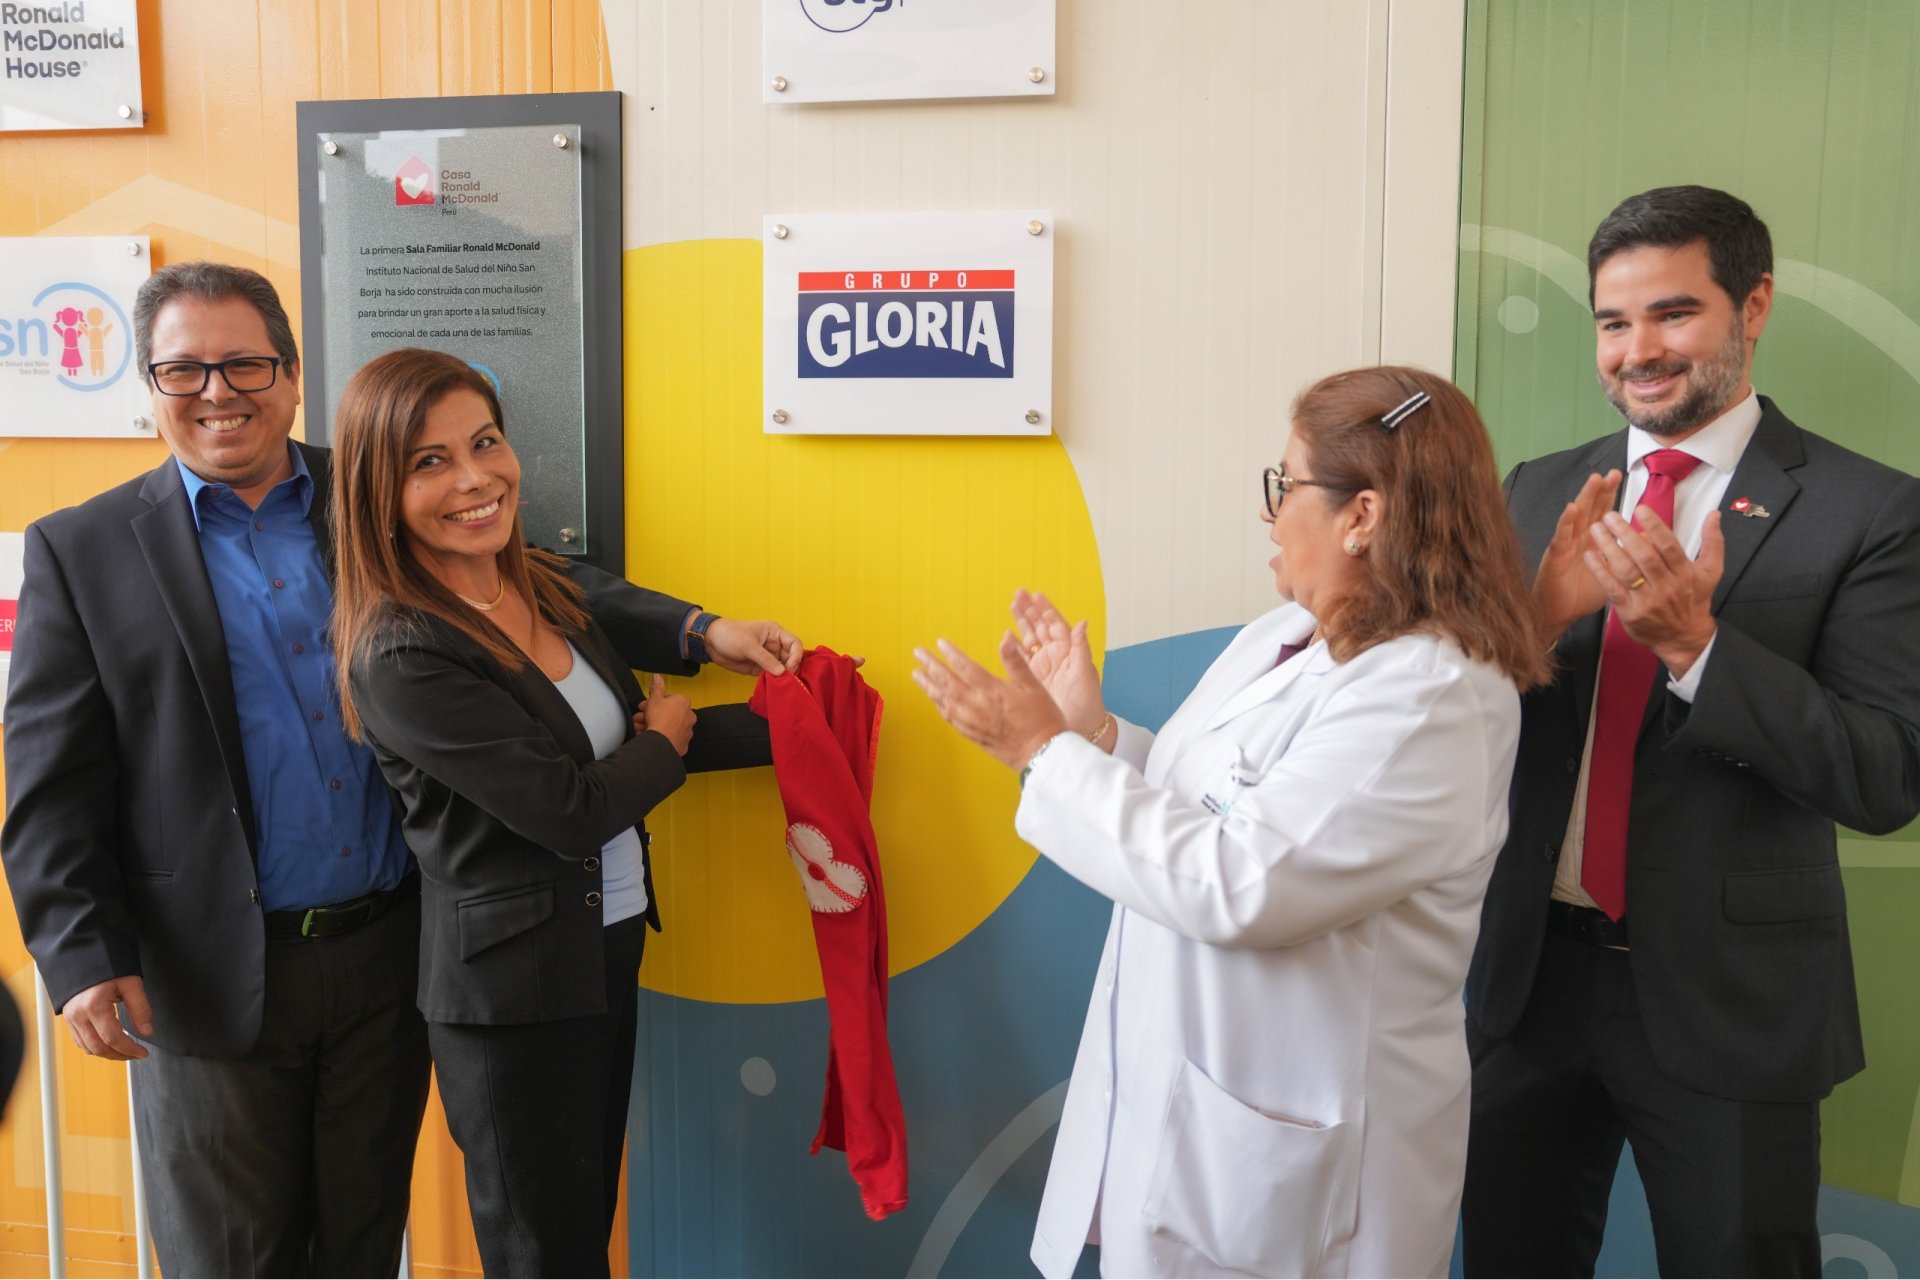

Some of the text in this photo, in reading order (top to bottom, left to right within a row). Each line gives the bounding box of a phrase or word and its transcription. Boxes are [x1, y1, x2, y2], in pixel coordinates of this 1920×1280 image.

[1, 1, 85, 24] Ronald
[4, 27, 124, 51] McDonald
[441, 170, 471, 179] Casa
[441, 181, 480, 191] Ronald
[441, 192, 499, 204] McDonald
[360, 242, 540, 256] La primera Sala Familiar Ronald McDonald
[366, 263, 536, 276] Instituto Nacional de Salud del Niño San
[844, 271, 968, 289] GRUPO
[360, 288, 382, 298] Borja
[385, 287, 396, 296] ha
[397, 286, 415, 296] sido
[417, 286, 462, 295] construida
[482, 285, 512, 294] mucha
[514, 284, 543, 293] ilusión
[358, 310, 376, 319] para
[378, 308, 409, 317] brindar
[410, 309, 421, 317] un
[423, 309, 442, 318] gran
[444, 307, 473, 317] aporte
[481, 306, 490, 315] la
[491, 306, 515, 315] salud
[538, 308, 545, 316] y
[371, 327, 533, 338] emocional de cada una de las familias.
[806, 300, 1006, 369] GLORIA
